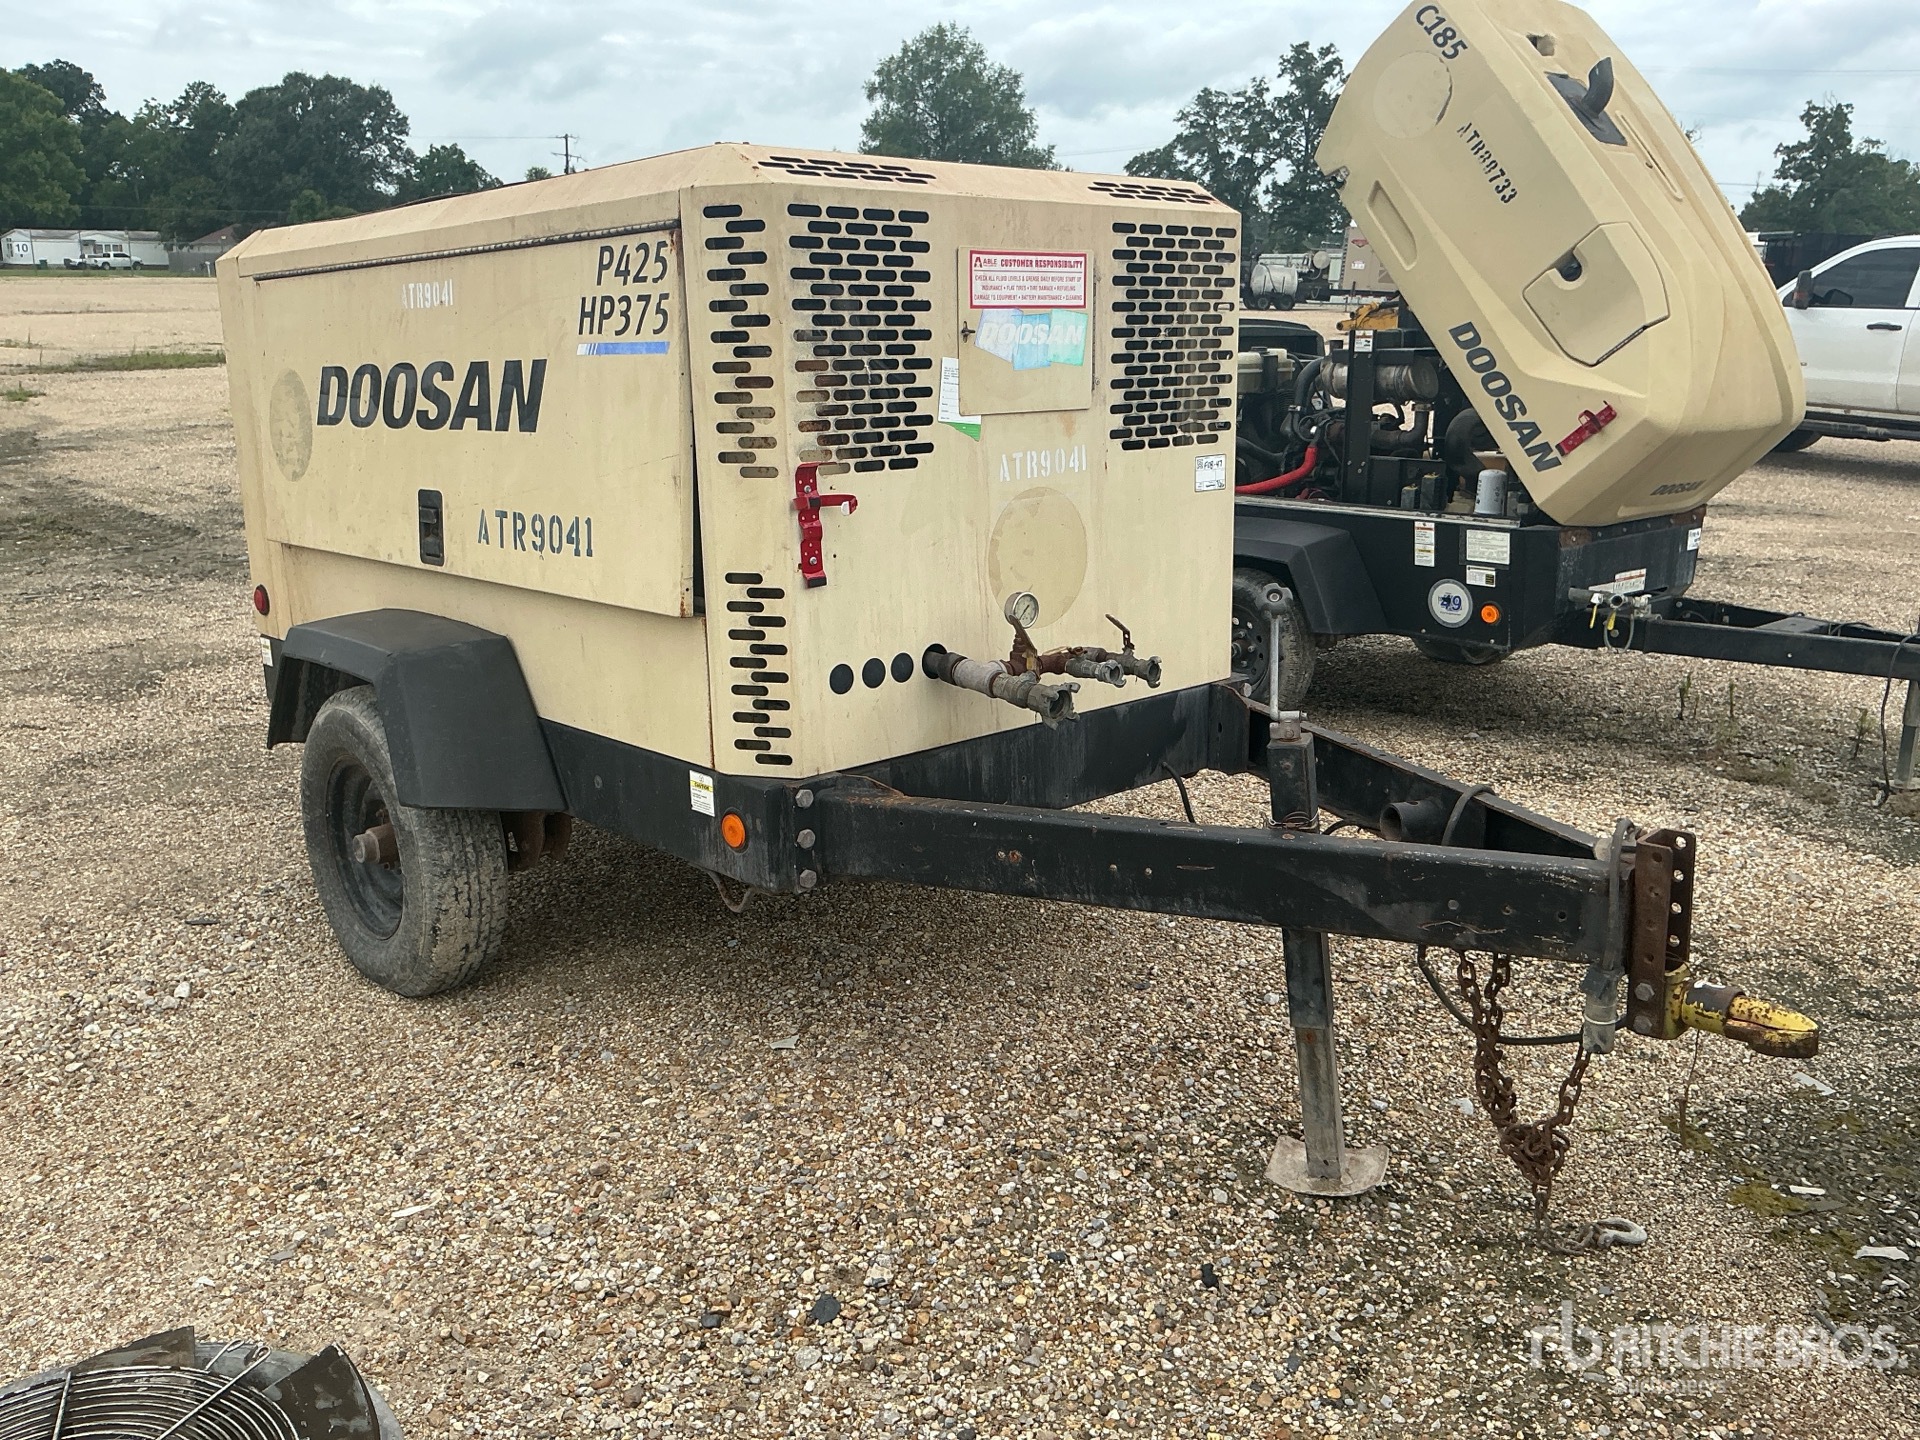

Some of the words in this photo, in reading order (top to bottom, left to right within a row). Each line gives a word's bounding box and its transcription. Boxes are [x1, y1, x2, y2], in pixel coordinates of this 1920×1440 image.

[1416, 5, 1468, 59] C185
[16, 244, 28, 252] 10
[596, 240, 669, 286] P425
[1001, 259, 1033, 267] CUSTOMER
[1035, 260, 1082, 268] RESPONSIBILITY
[402, 279, 453, 309] ATR9041
[578, 292, 670, 336] HP375
[980, 323, 1082, 344] DOOSAN
[317, 358, 548, 433] DOOSAN
[1448, 321, 1562, 473] DOOSAN
[999, 444, 1087, 482] ATR9041
[478, 508, 593, 557] ATR9041
